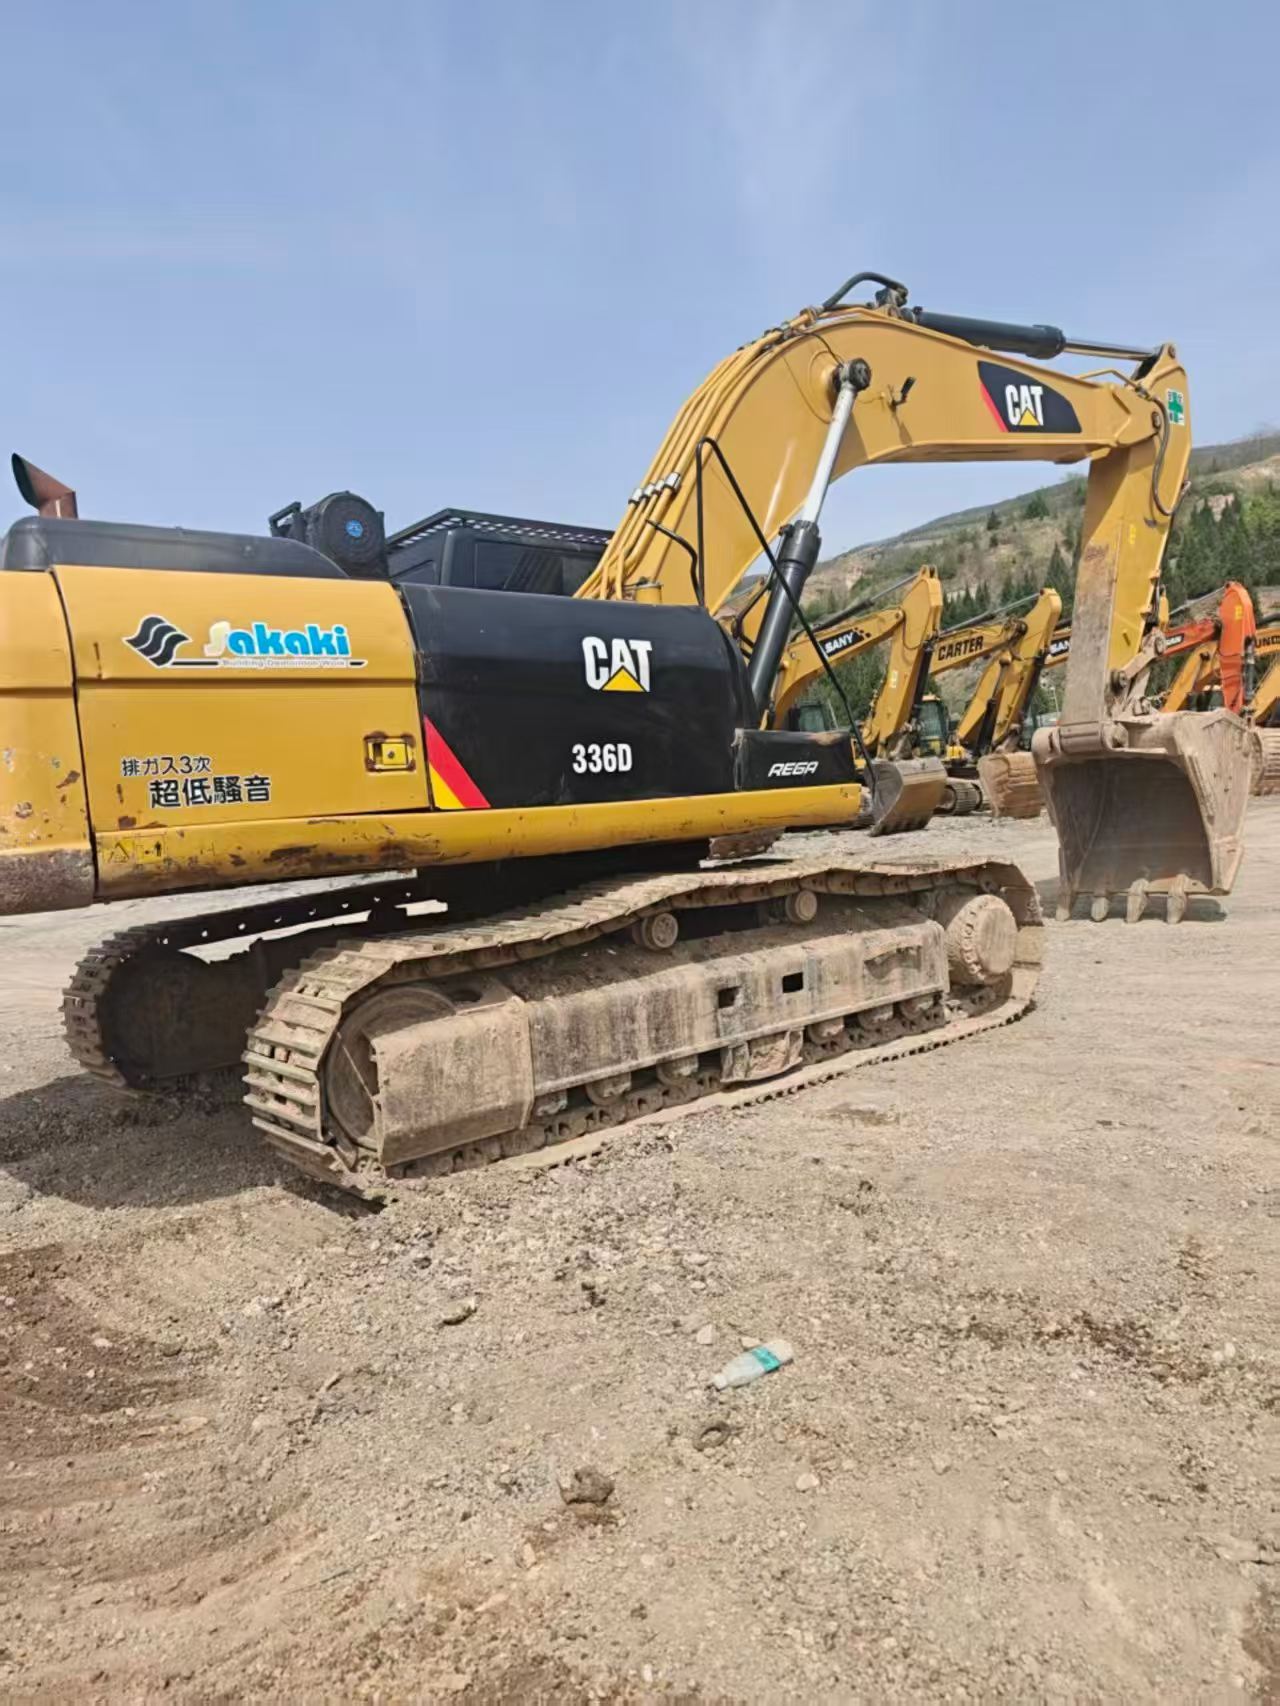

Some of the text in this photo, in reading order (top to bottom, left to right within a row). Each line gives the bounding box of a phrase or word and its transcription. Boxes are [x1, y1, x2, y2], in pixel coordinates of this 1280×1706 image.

[1005, 384, 1044, 426] CAT
[205, 621, 351, 656] Sakaki
[825, 632, 853, 653] SANY
[938, 635, 983, 661] CARTER
[1050, 640, 1070, 654] SAN
[582, 636, 653, 692] CAT
[122, 756, 211, 776] 排ガス3次
[572, 743, 633, 774] 336D
[768, 761, 818, 777] REGA
[150, 775, 271, 808] 超低騒音
